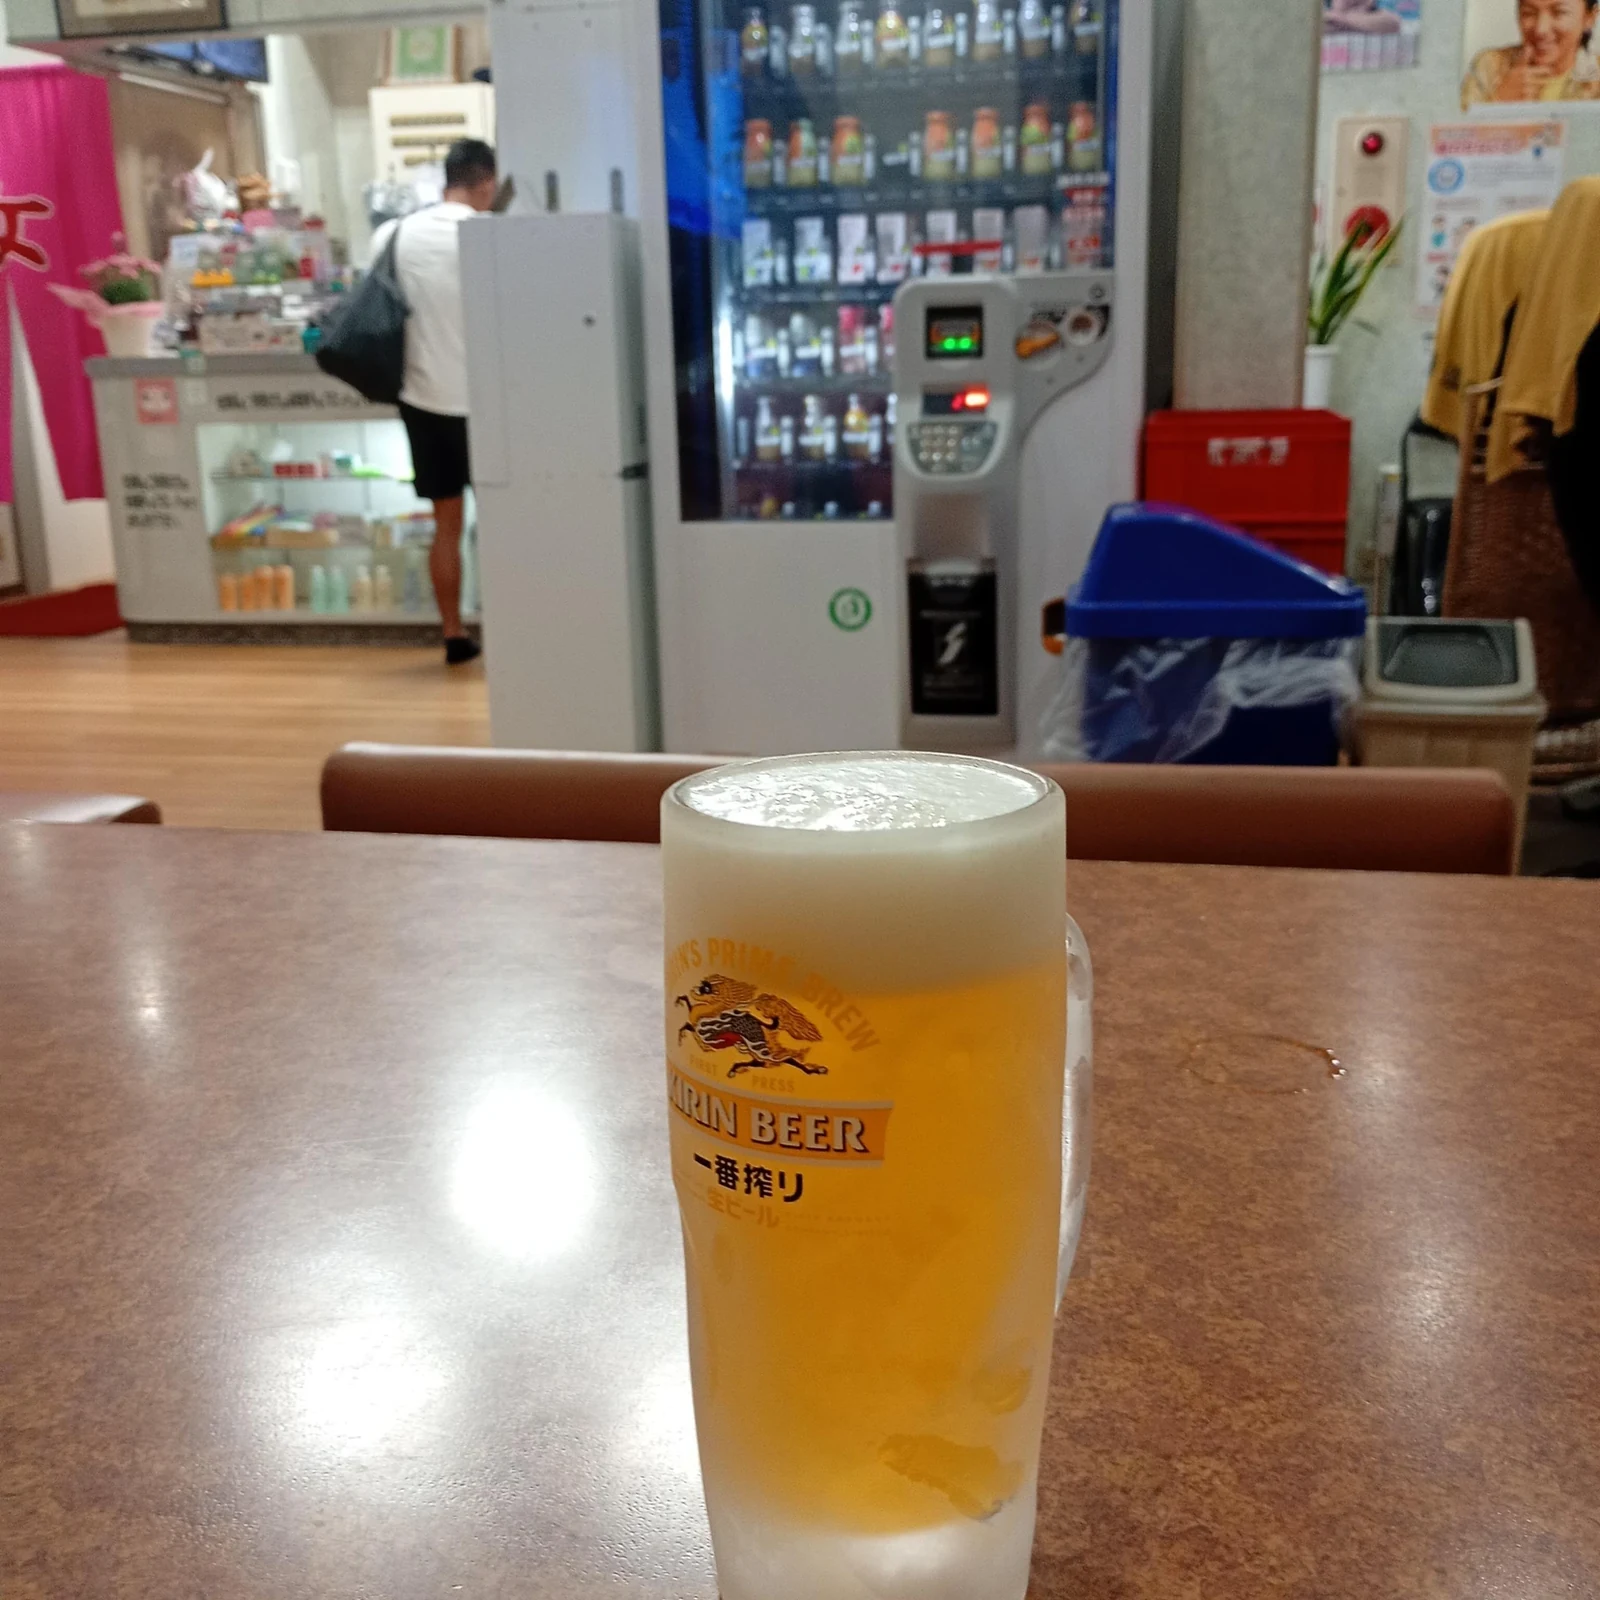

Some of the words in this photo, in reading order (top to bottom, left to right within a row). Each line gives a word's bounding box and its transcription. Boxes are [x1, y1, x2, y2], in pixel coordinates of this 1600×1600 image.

[801, 972, 881, 1052] BREW
[669, 1074, 738, 1138] KIRIN
[750, 1107, 870, 1153] BEER
[751, 1074, 795, 1093] PRESS
[694, 1153, 804, 1203] 一番搾り
